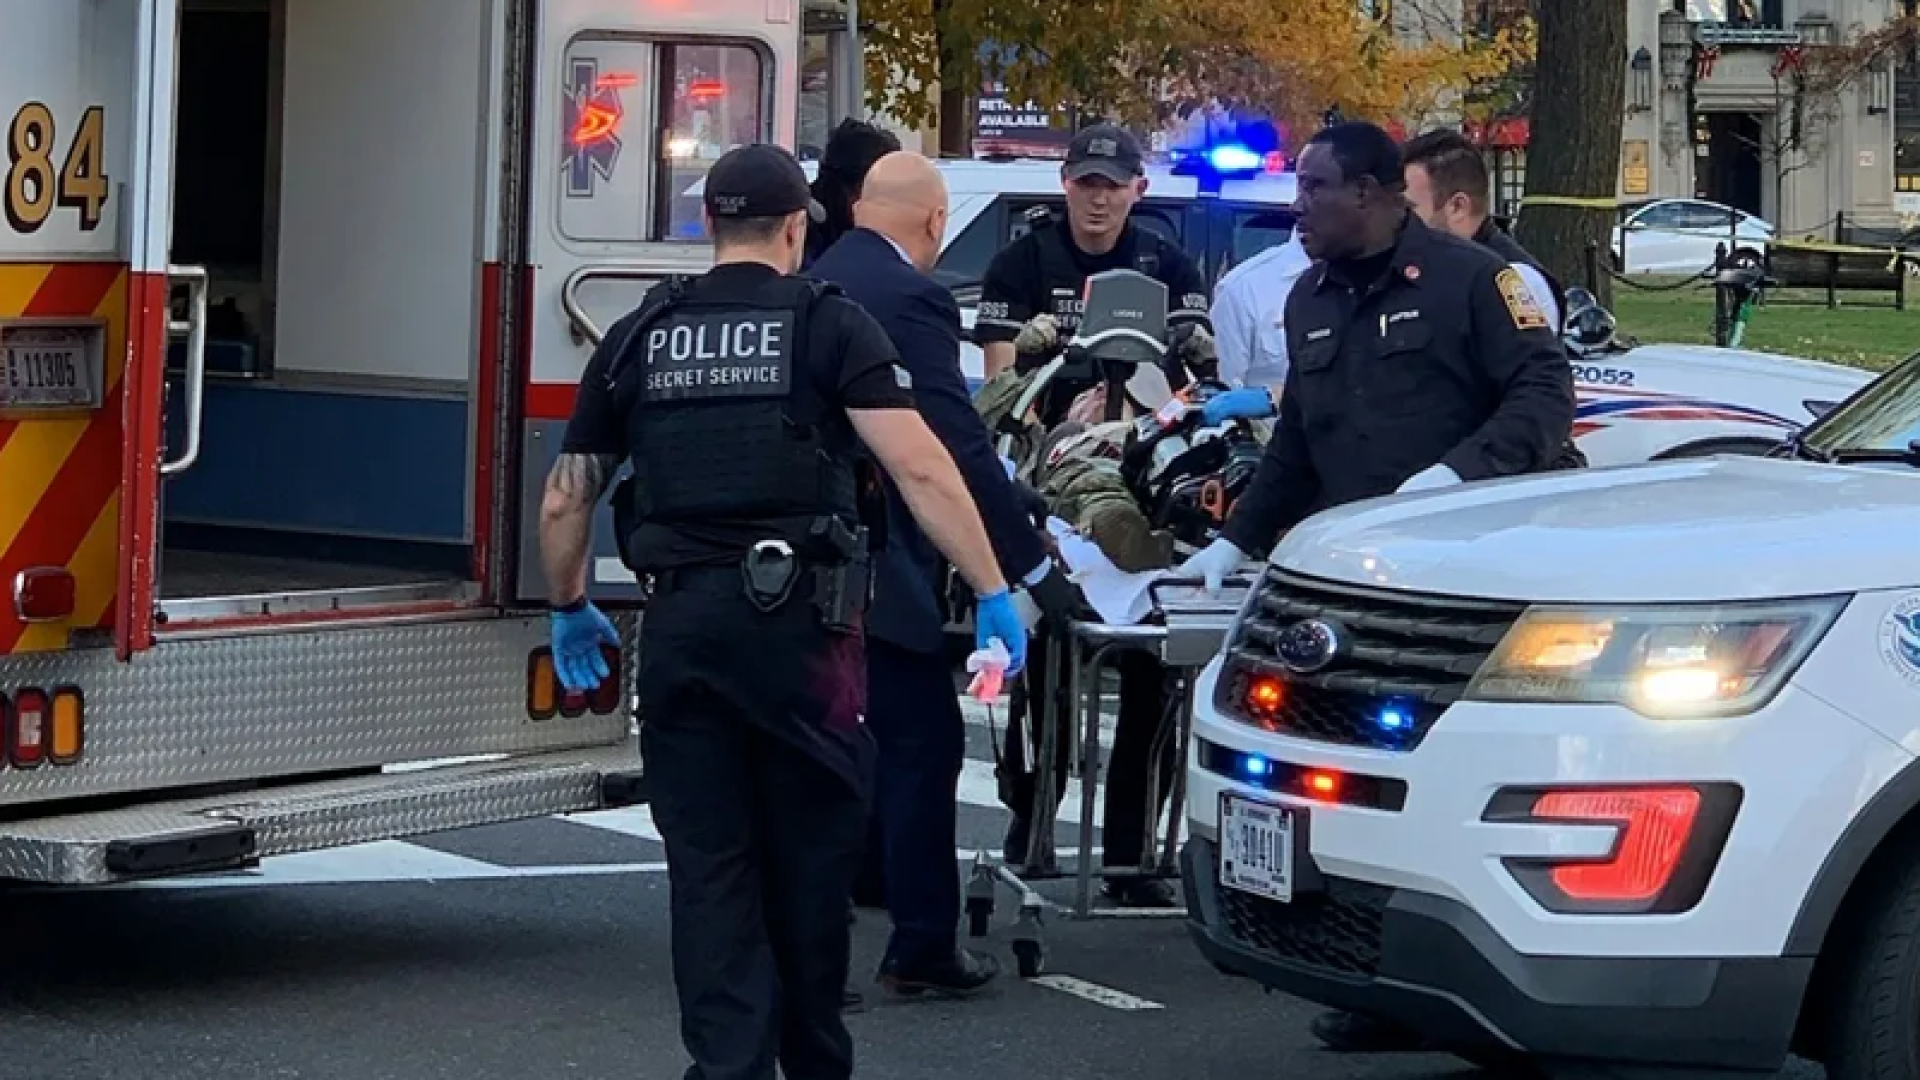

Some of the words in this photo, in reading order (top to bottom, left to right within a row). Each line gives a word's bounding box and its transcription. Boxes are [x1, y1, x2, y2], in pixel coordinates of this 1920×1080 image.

[979, 114, 1050, 127] AVAILABLE
[5, 101, 108, 233] 84
[647, 321, 783, 363] POLICE
[647, 368, 703, 390] SECRET
[709, 366, 780, 386] SERVICE
[1570, 365, 1635, 387] 2052
